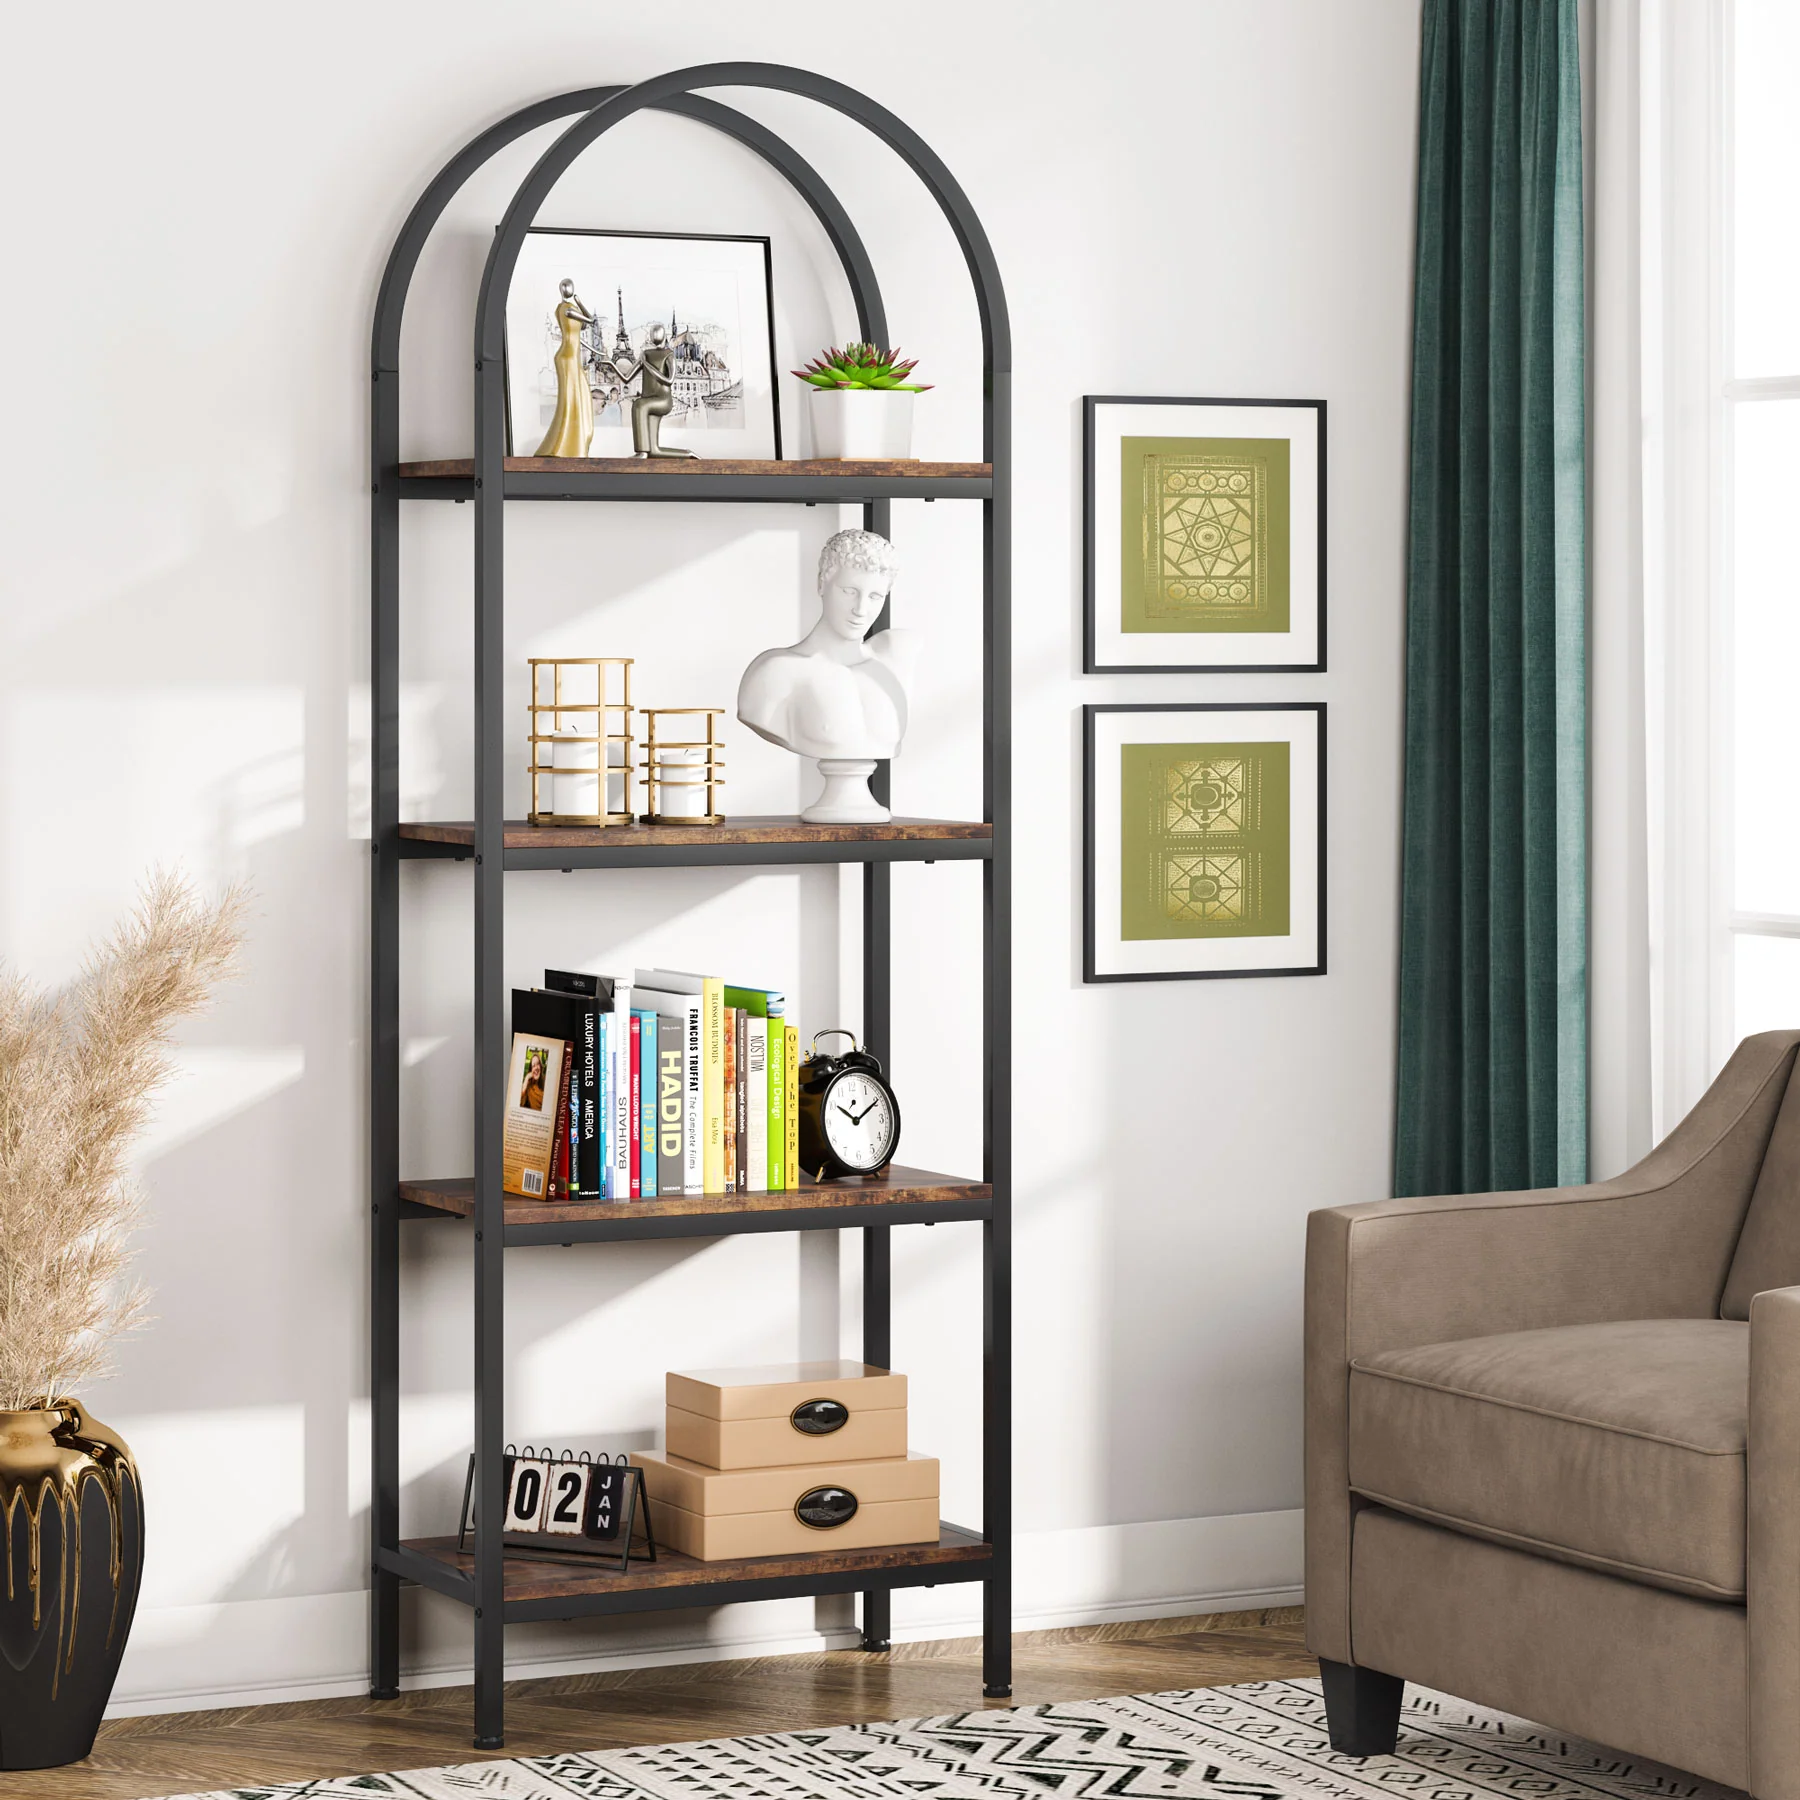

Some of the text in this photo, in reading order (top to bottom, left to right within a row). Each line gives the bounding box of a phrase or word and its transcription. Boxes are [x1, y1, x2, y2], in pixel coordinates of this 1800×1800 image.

[711, 993, 719, 1065] BLOSSOM BUDDIES
[750, 1035, 765, 1072] WILLSON
[584, 1013, 594, 1140] LUXURY HOTELS AMERICA
[771, 1038, 782, 1119] Ecological Design
[847, 1081, 857, 1092] 12
[688, 1008, 698, 1170] FRANCOIS TRUFFAT The Complete Films
[837, 1086, 844, 1098] 11
[863, 1085, 868, 1096] 1
[661, 1050, 682, 1157] HADID
[829, 1099, 837, 1110] 10
[557, 1116, 565, 1136] LEAF
[878, 1113, 885, 1124] 3
[618, 1097, 627, 1169] BAUHAUS
[643, 1124, 655, 1154] ART
[877, 1131, 882, 1142] 4
[843, 1146, 848, 1157] 7
[855, 1150, 862, 1161] 6
[869, 1143, 875, 1154] 5
[597, 1475, 612, 1529] JAN
